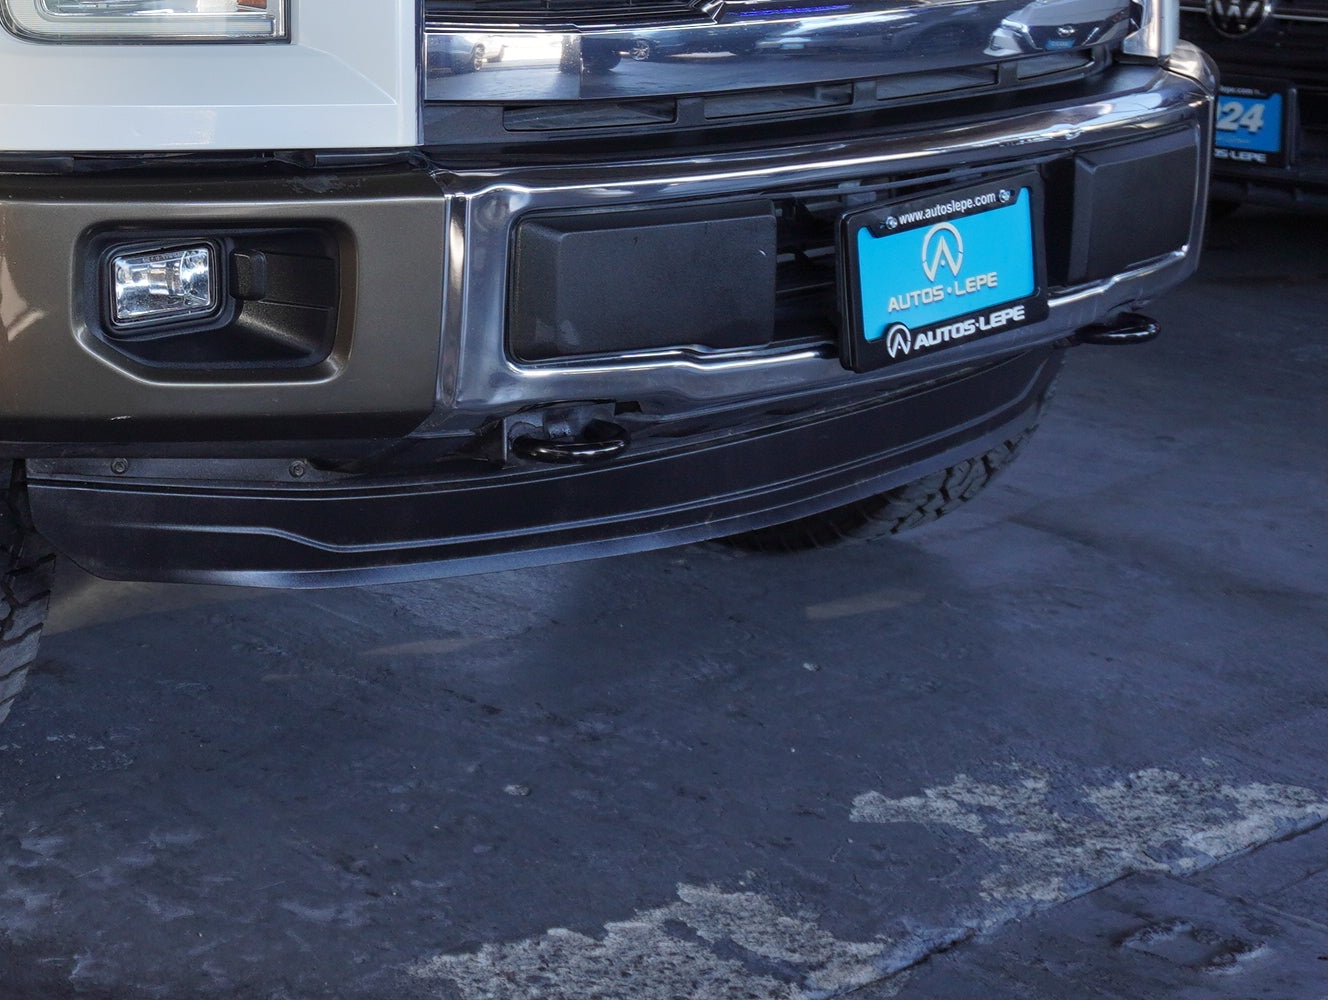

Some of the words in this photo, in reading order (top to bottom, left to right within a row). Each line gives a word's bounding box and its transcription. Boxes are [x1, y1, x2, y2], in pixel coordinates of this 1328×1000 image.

[1215, 101, 1266, 133] 24
[898, 191, 997, 225] www.autoslepe.com
[887, 284, 944, 313] AUTOS
[954, 271, 998, 297] LEPE
